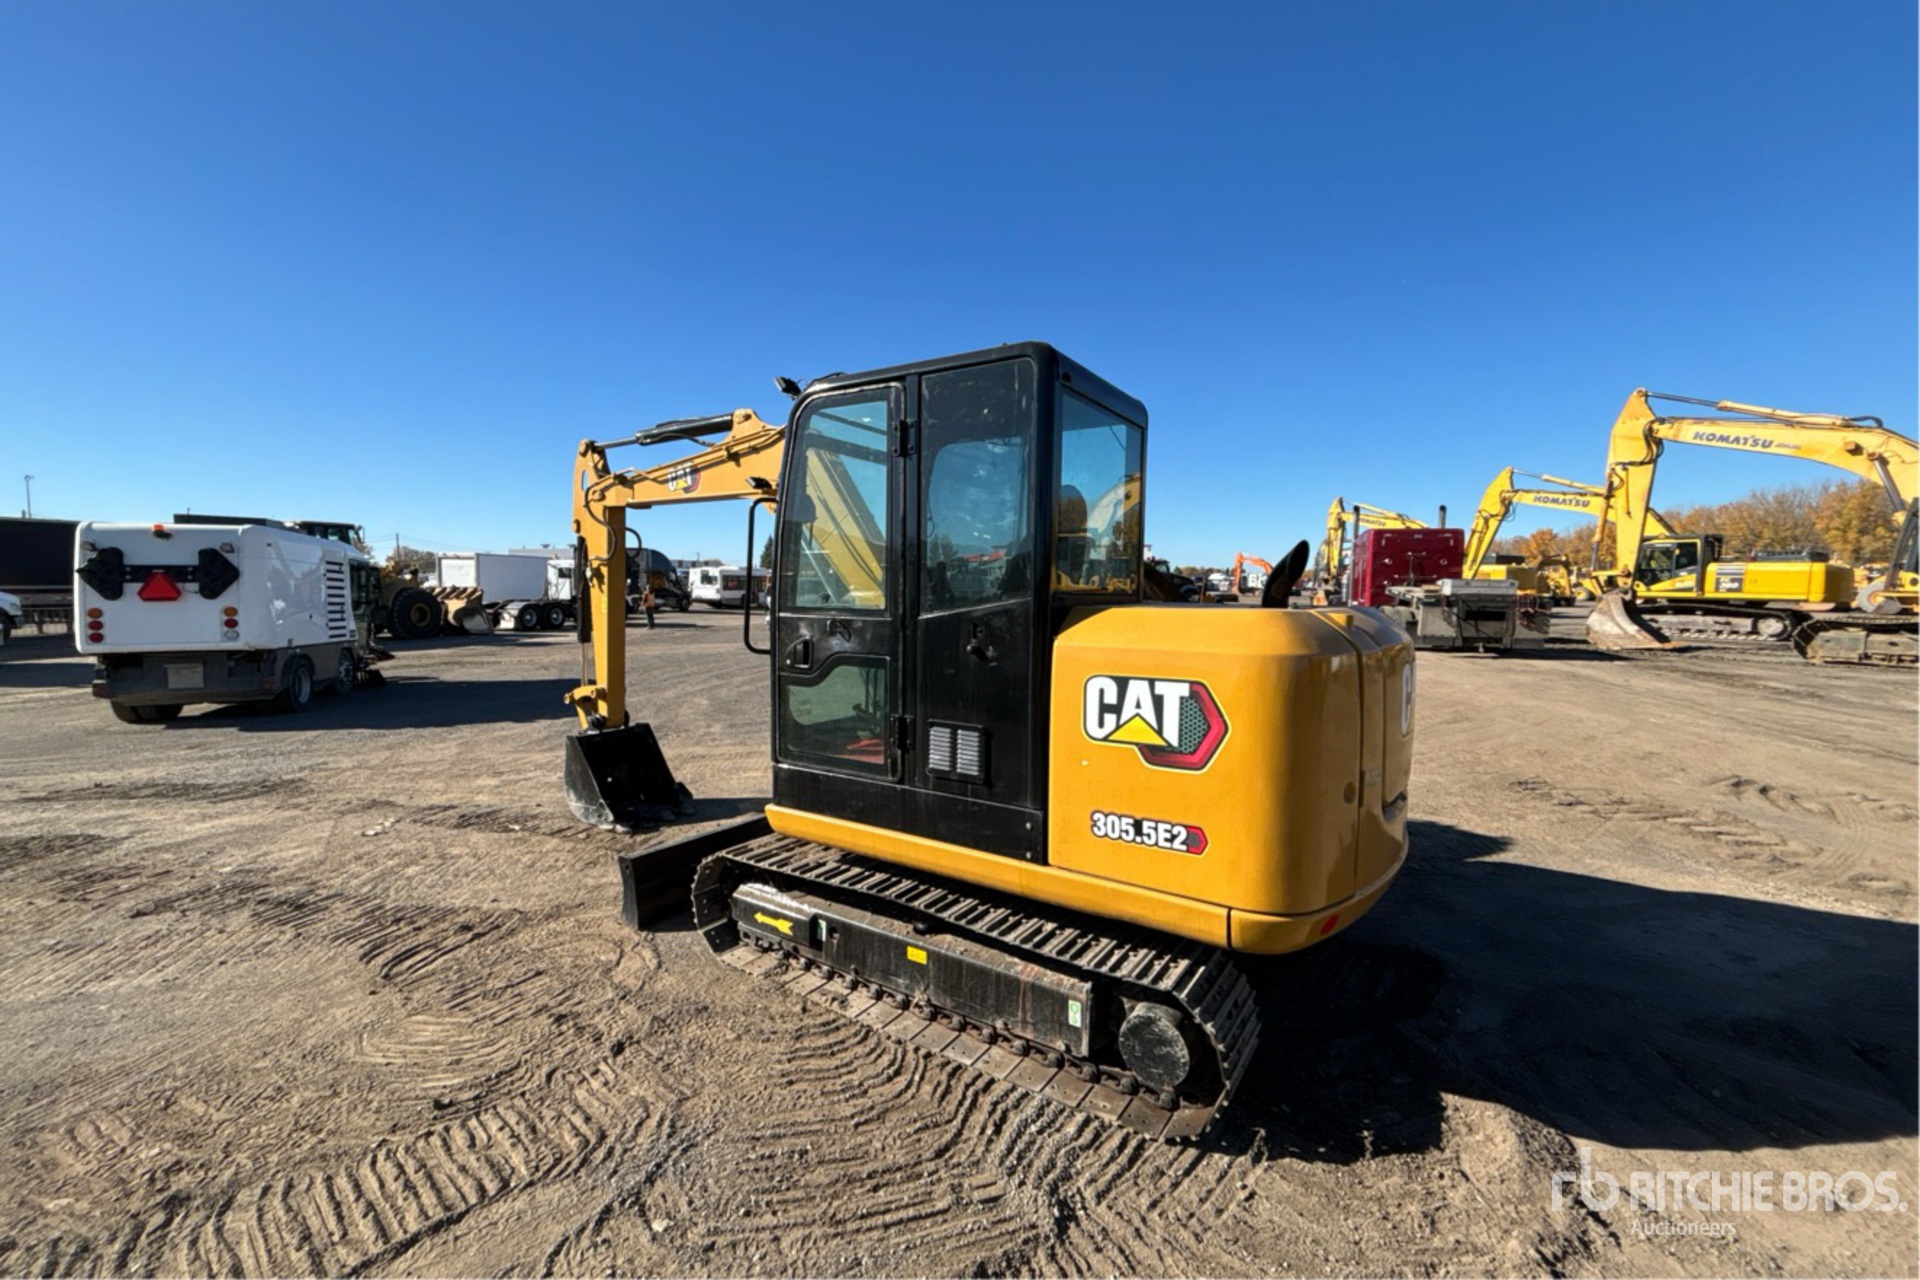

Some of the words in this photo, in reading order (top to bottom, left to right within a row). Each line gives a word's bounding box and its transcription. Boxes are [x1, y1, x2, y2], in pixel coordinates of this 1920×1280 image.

[1693, 431, 1774, 449] KOMATSU
[668, 461, 694, 491] CAT
[1534, 495, 1590, 507] KOMATSU
[1086, 676, 1190, 748] CAT
[1092, 811, 1188, 852] 305.5E2
